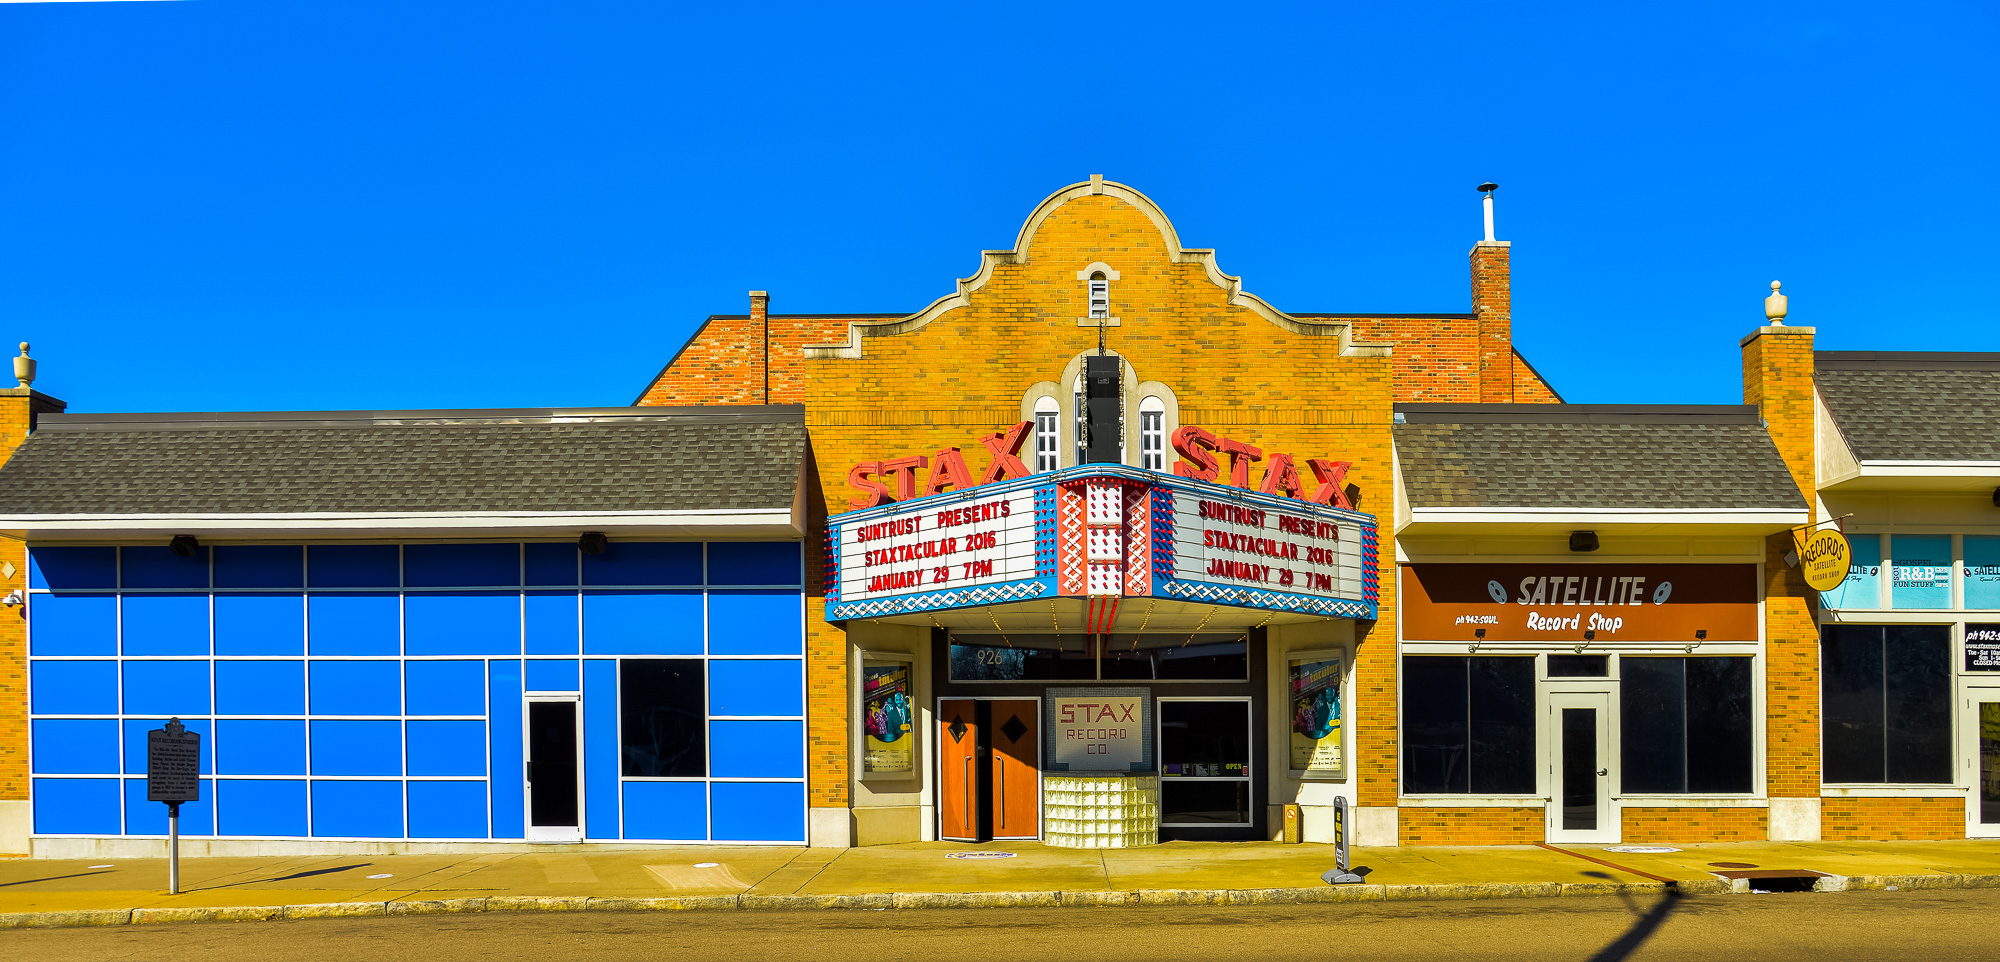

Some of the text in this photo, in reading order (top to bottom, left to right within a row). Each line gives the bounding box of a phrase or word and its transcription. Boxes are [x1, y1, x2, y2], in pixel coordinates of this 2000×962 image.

[847, 421, 1035, 511] STAX
[1171, 425, 1354, 511] STAX
[857, 499, 1010, 543] SUNTRUST PRESENTS
[1199, 500, 1339, 542] SUNTRUST PRESENTS
[865, 530, 996, 567] STAXTACULAR 2016
[1204, 529, 1333, 566] STAXTACULAR 2016
[1805, 536, 1844, 567] RECORDS
[1207, 558, 1270, 583] JANUARY
[1279, 568, 1294, 587] 29
[1812, 572, 1828, 581] RECORD
[1829, 570, 1840, 579] SHOP
[1813, 559, 1836, 571] SATELLITE
[1900, 567, 1935, 581] R&B
[1974, 564, 2000, 575] SATELL
[867, 569, 924, 593] JANUARY
[933, 566, 950, 584] 29
[1910, 580, 1935, 588] STUFF
[1516, 576, 1646, 606] SATELLITE
[1455, 614, 1499, 626] ph 942-SOUL
[1526, 611, 1623, 634] Record Shop
[1966, 630, 1978, 642] ph
[977, 650, 1002, 664] 926
[1061, 703, 1135, 723] STAX
[1067, 728, 1127, 740] RECORD
[1087, 744, 1110, 754] CO.
